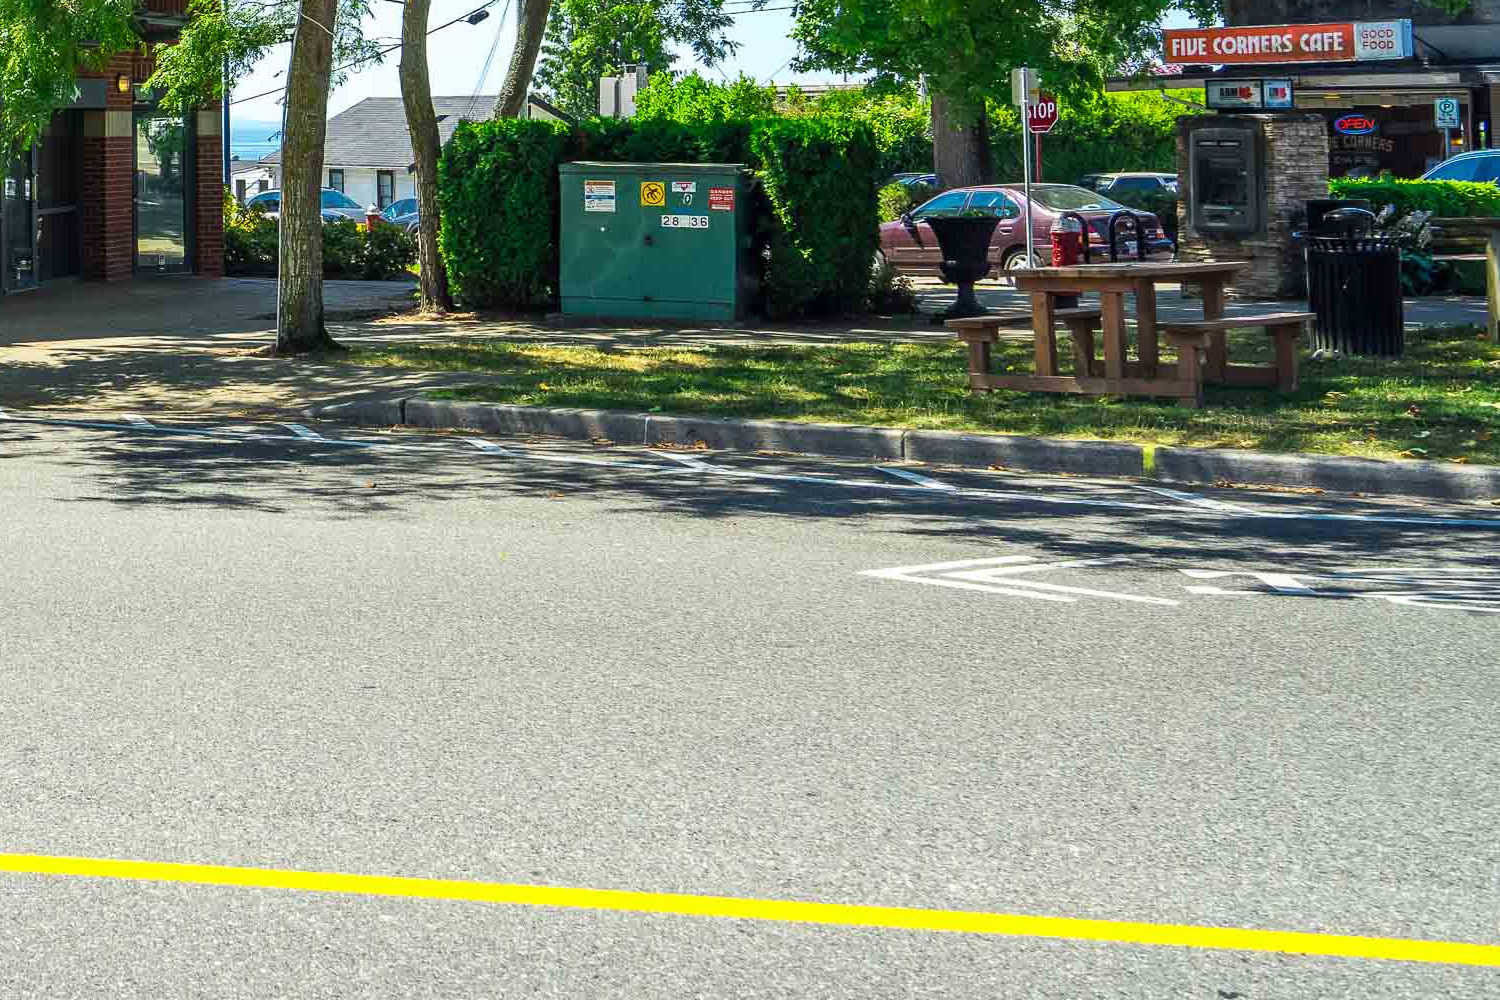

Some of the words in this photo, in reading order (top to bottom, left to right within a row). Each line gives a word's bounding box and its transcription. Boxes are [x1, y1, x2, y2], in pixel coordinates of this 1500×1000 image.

[1361, 29, 1394, 39] GOOD
[1172, 37, 1207, 56] FIVE
[1213, 33, 1293, 54] CORNERS
[1300, 31, 1344, 51] CAFE
[1362, 40, 1395, 50] FOOD
[1336, 118, 1375, 129] OPEN
[663, 216, 679, 226] 28
[691, 217, 708, 227] 36
